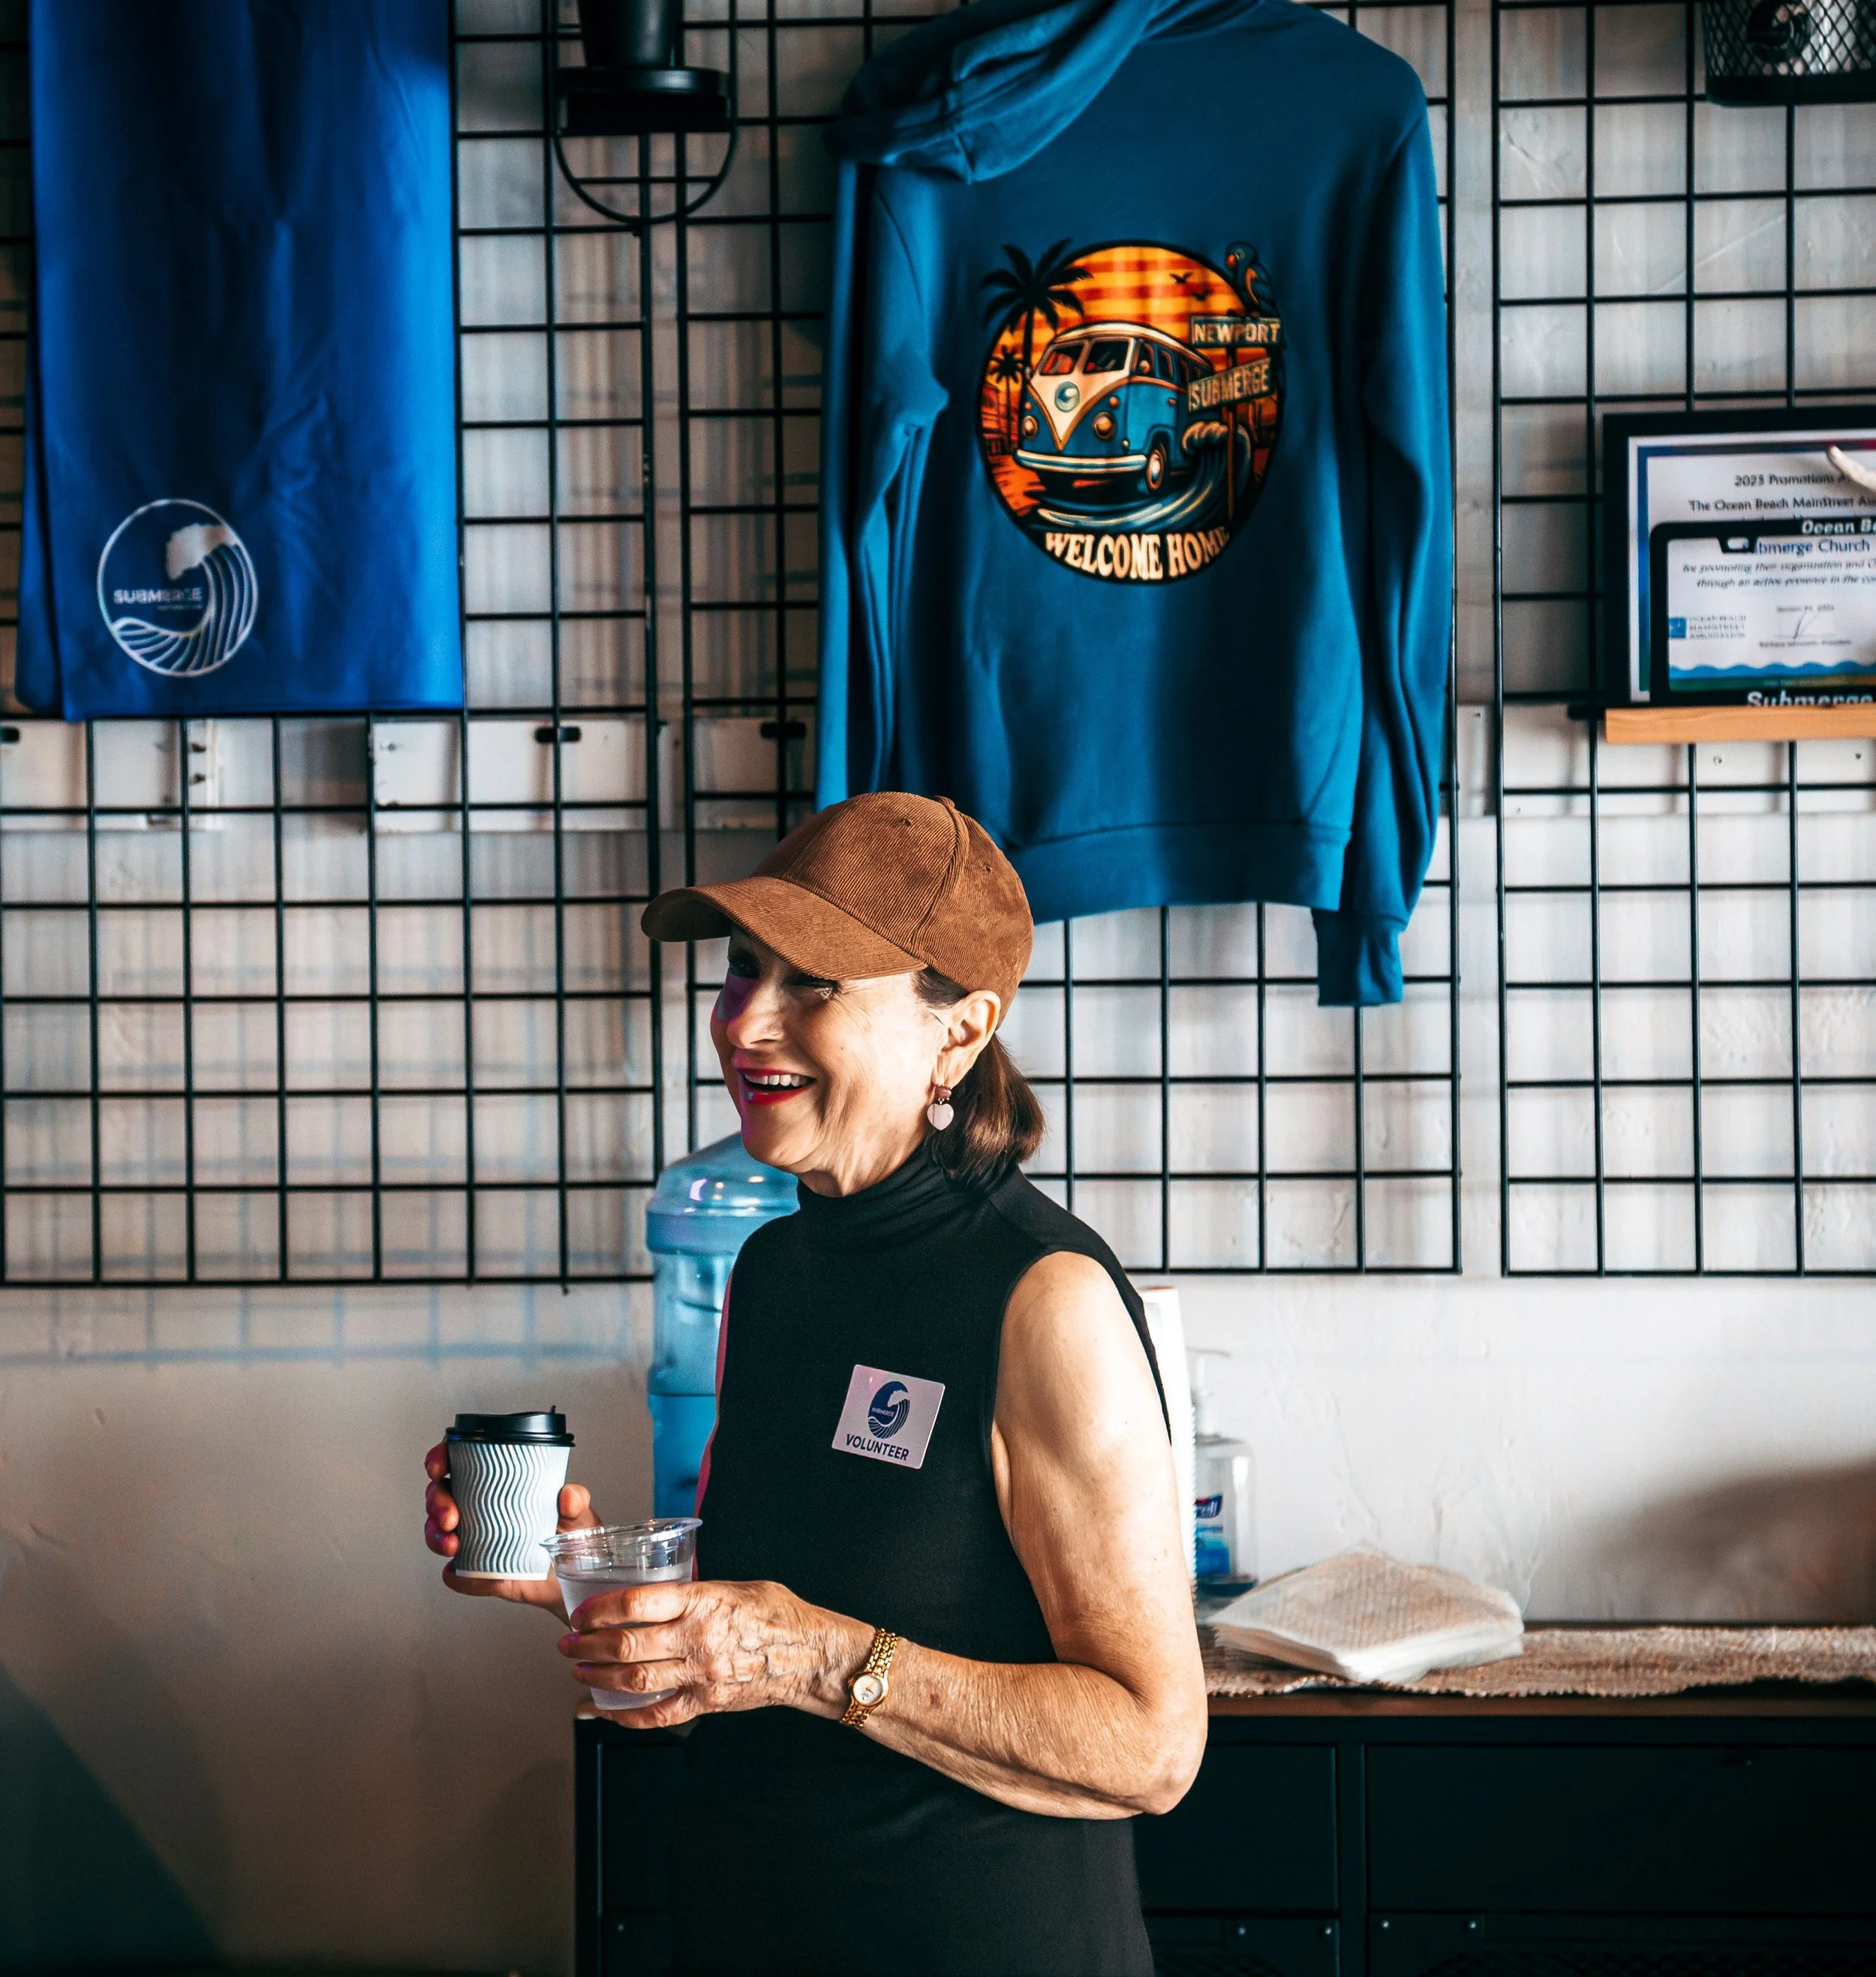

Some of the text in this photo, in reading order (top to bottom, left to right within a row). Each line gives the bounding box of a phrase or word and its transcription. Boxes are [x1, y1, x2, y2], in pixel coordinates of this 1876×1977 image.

[1194, 323, 1280, 343] NEWPORT
[1190, 363, 1270, 410] SUBMERGE
[1735, 474, 1765, 487] 2023
[1769, 472, 1835, 486] Promotions
[1689, 499, 1711, 511] The
[1714, 498, 1752, 511] Ocean
[1756, 497, 1790, 510] Beach
[1793, 495, 1853, 509] MainStreet
[1802, 519, 1856, 534] Ocean
[1045, 526, 1229, 579] WELCOME HOME
[1756, 538, 1870, 556] bmerge Church
[846, 1434, 909, 1461] VOLUNTEER
